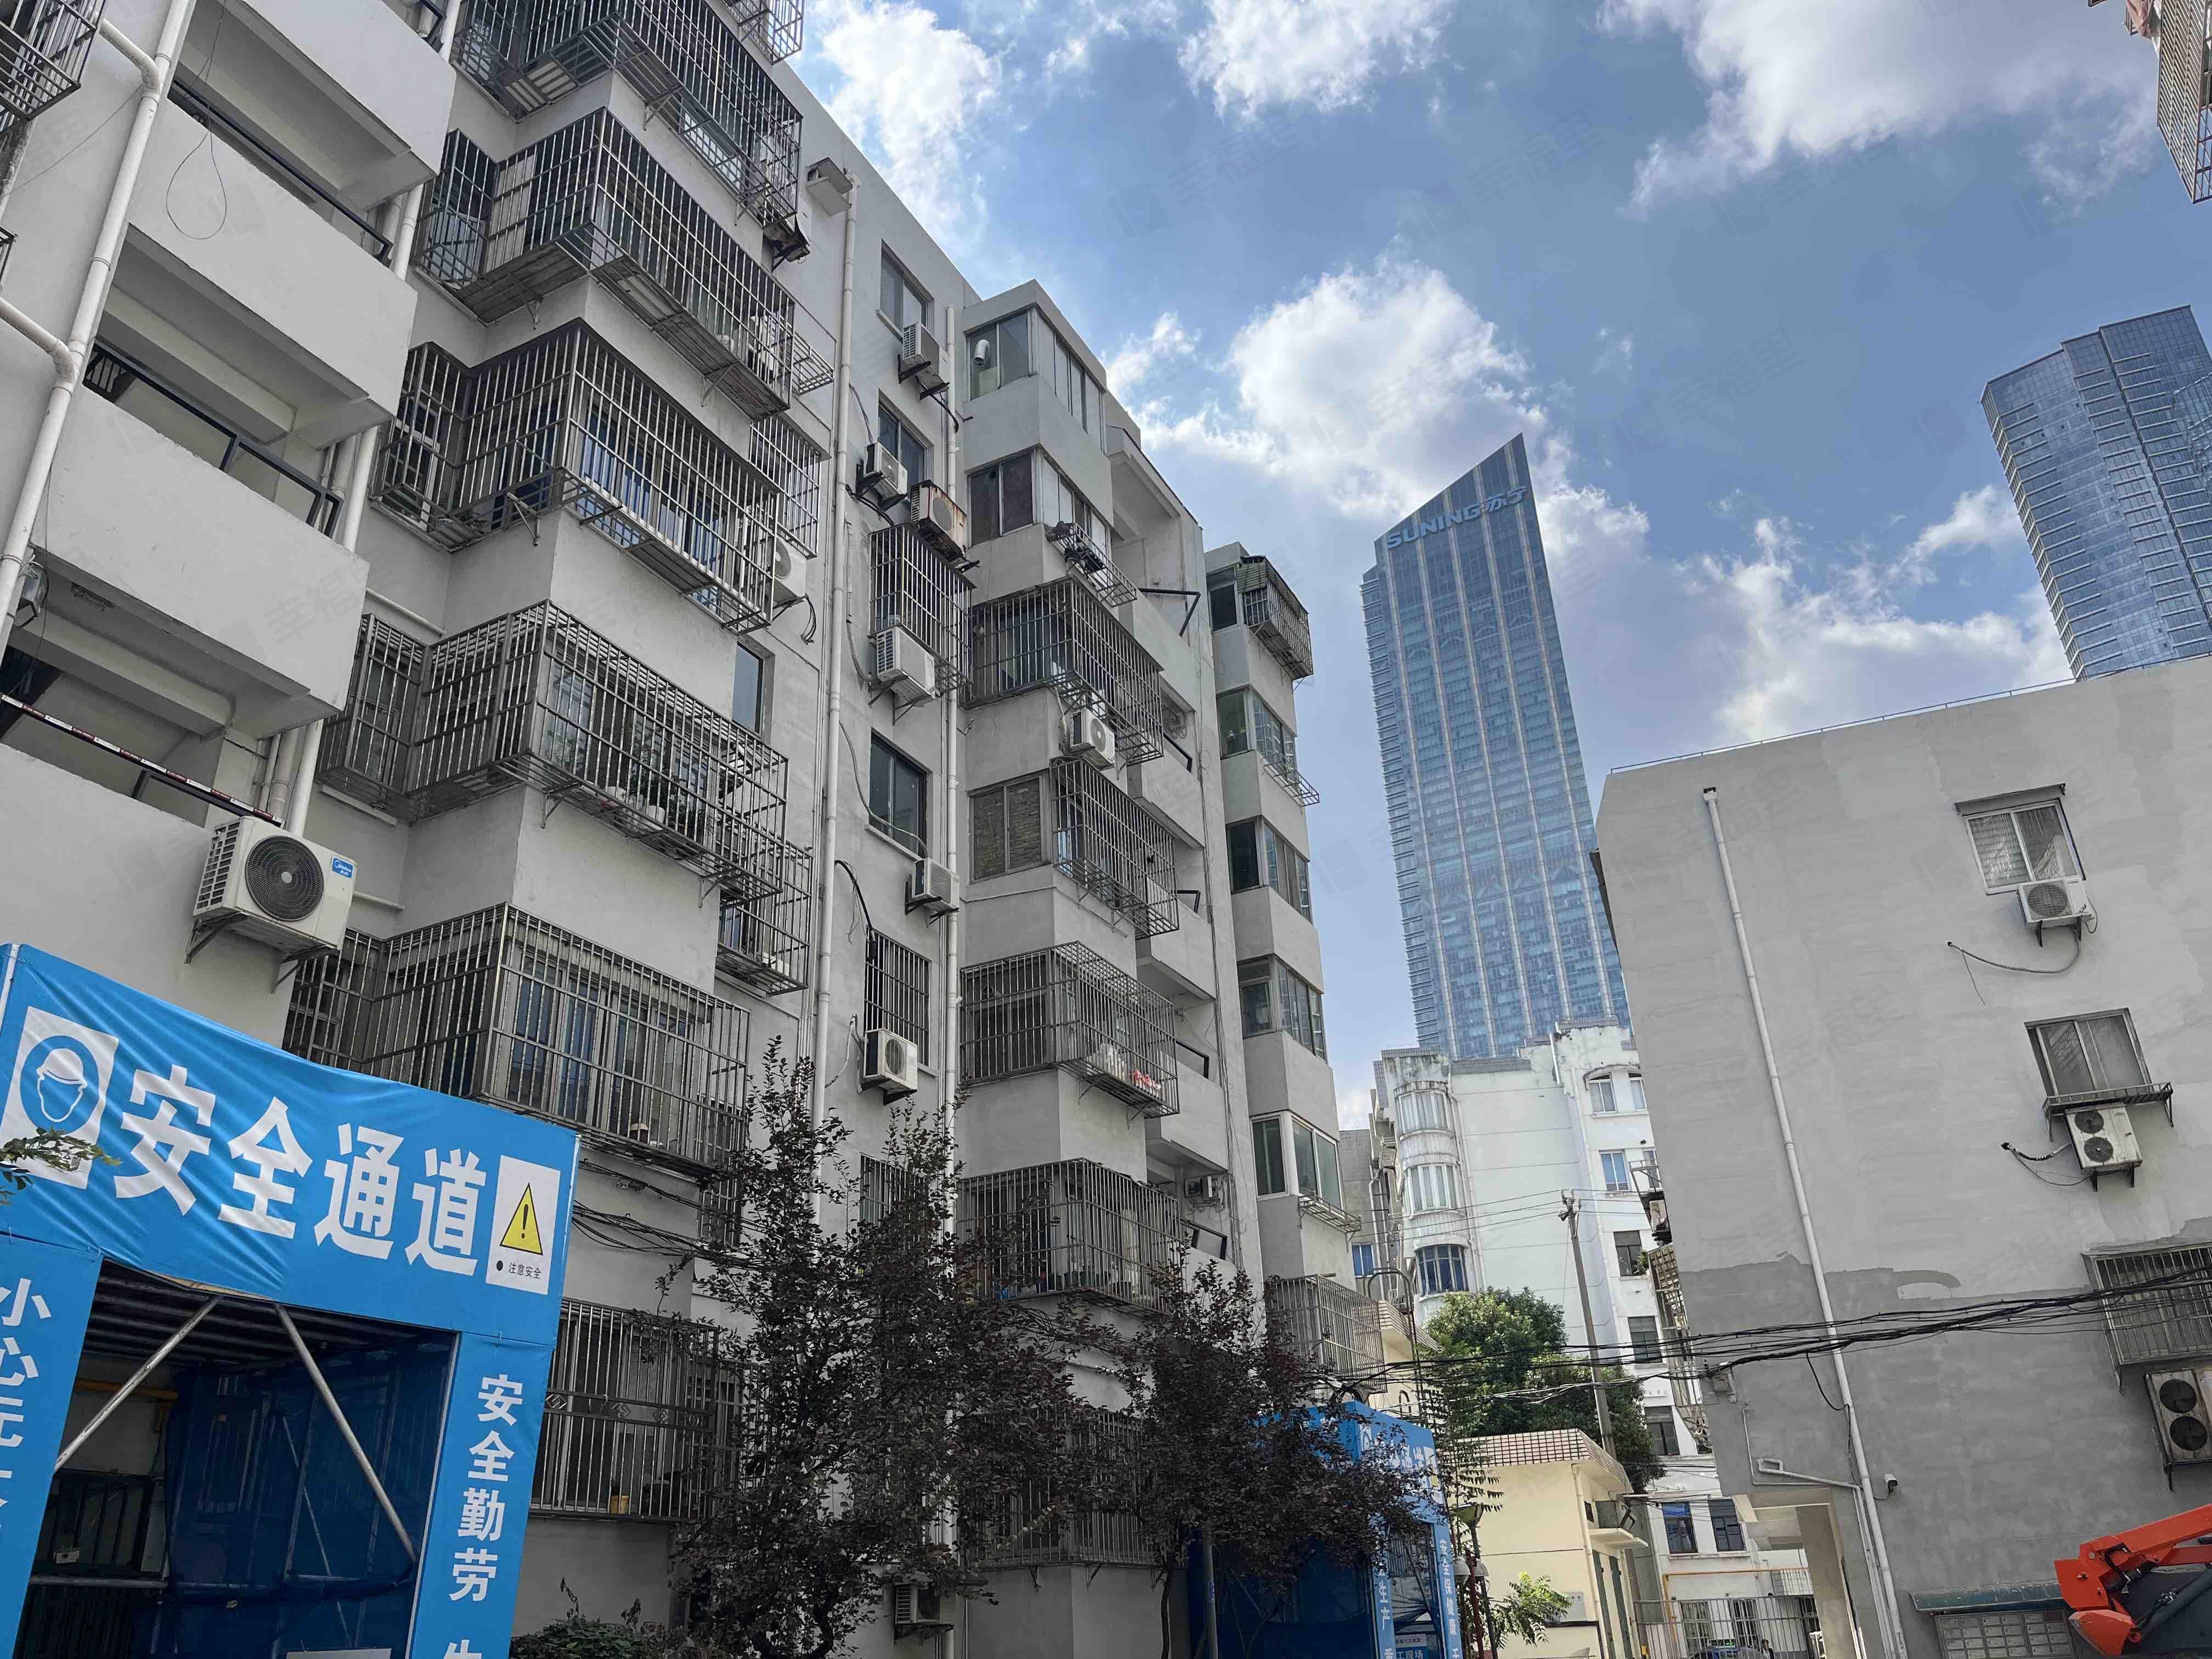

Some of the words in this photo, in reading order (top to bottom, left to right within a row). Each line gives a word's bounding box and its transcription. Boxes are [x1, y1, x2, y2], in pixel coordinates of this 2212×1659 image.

[1386, 501, 1481, 549] SUNING
[113, 1063, 486, 1276] 安全通道
[509, 1262, 541, 1279] 注意安全
[449, 1373, 523, 1602] 安全勤劳
